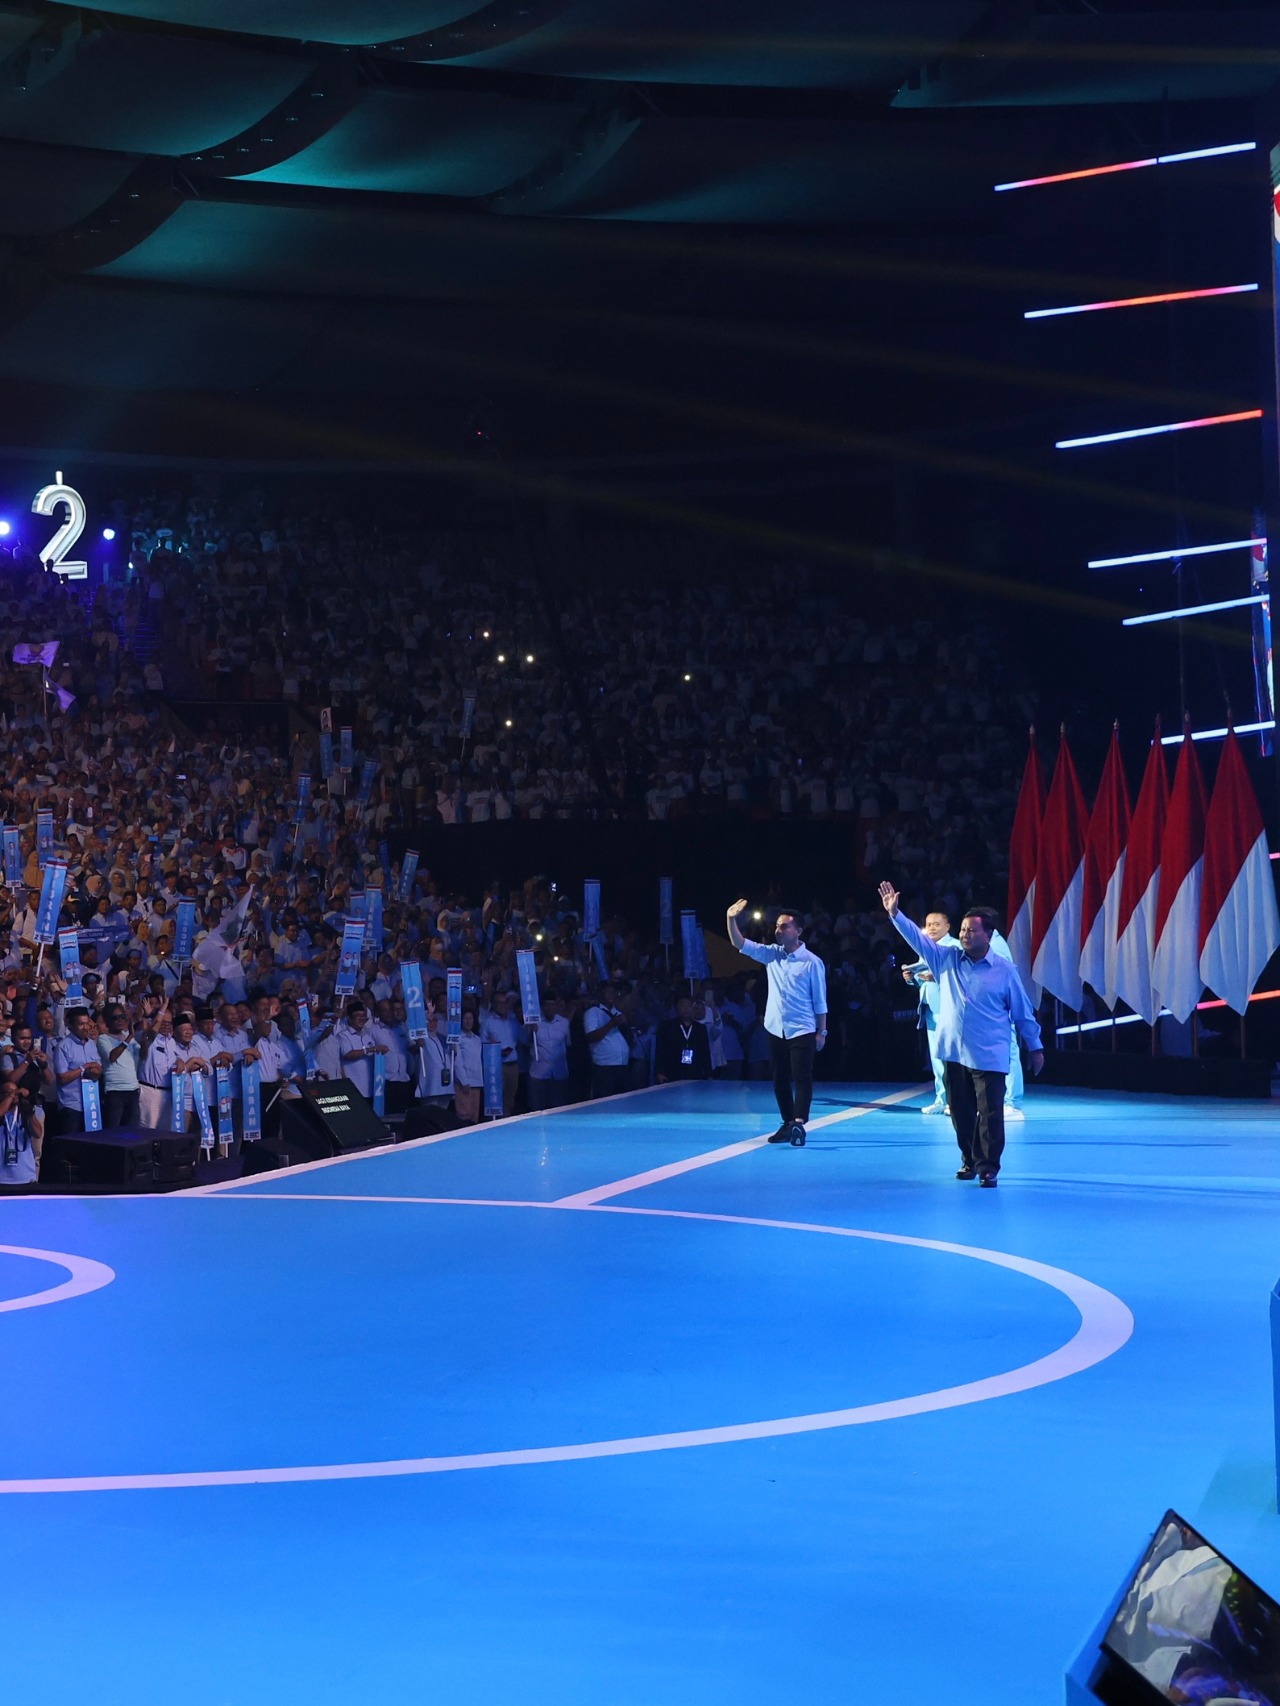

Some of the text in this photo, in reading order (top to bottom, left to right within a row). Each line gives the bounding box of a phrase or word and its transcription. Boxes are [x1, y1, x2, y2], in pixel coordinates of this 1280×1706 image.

[31, 483, 88, 580] 2
[407, 985, 422, 1008] 2
[88, 1085, 98, 1128] PRABO
[247, 1066, 256, 1126] GIBRAN
[375, 1075, 384, 1097] 2
